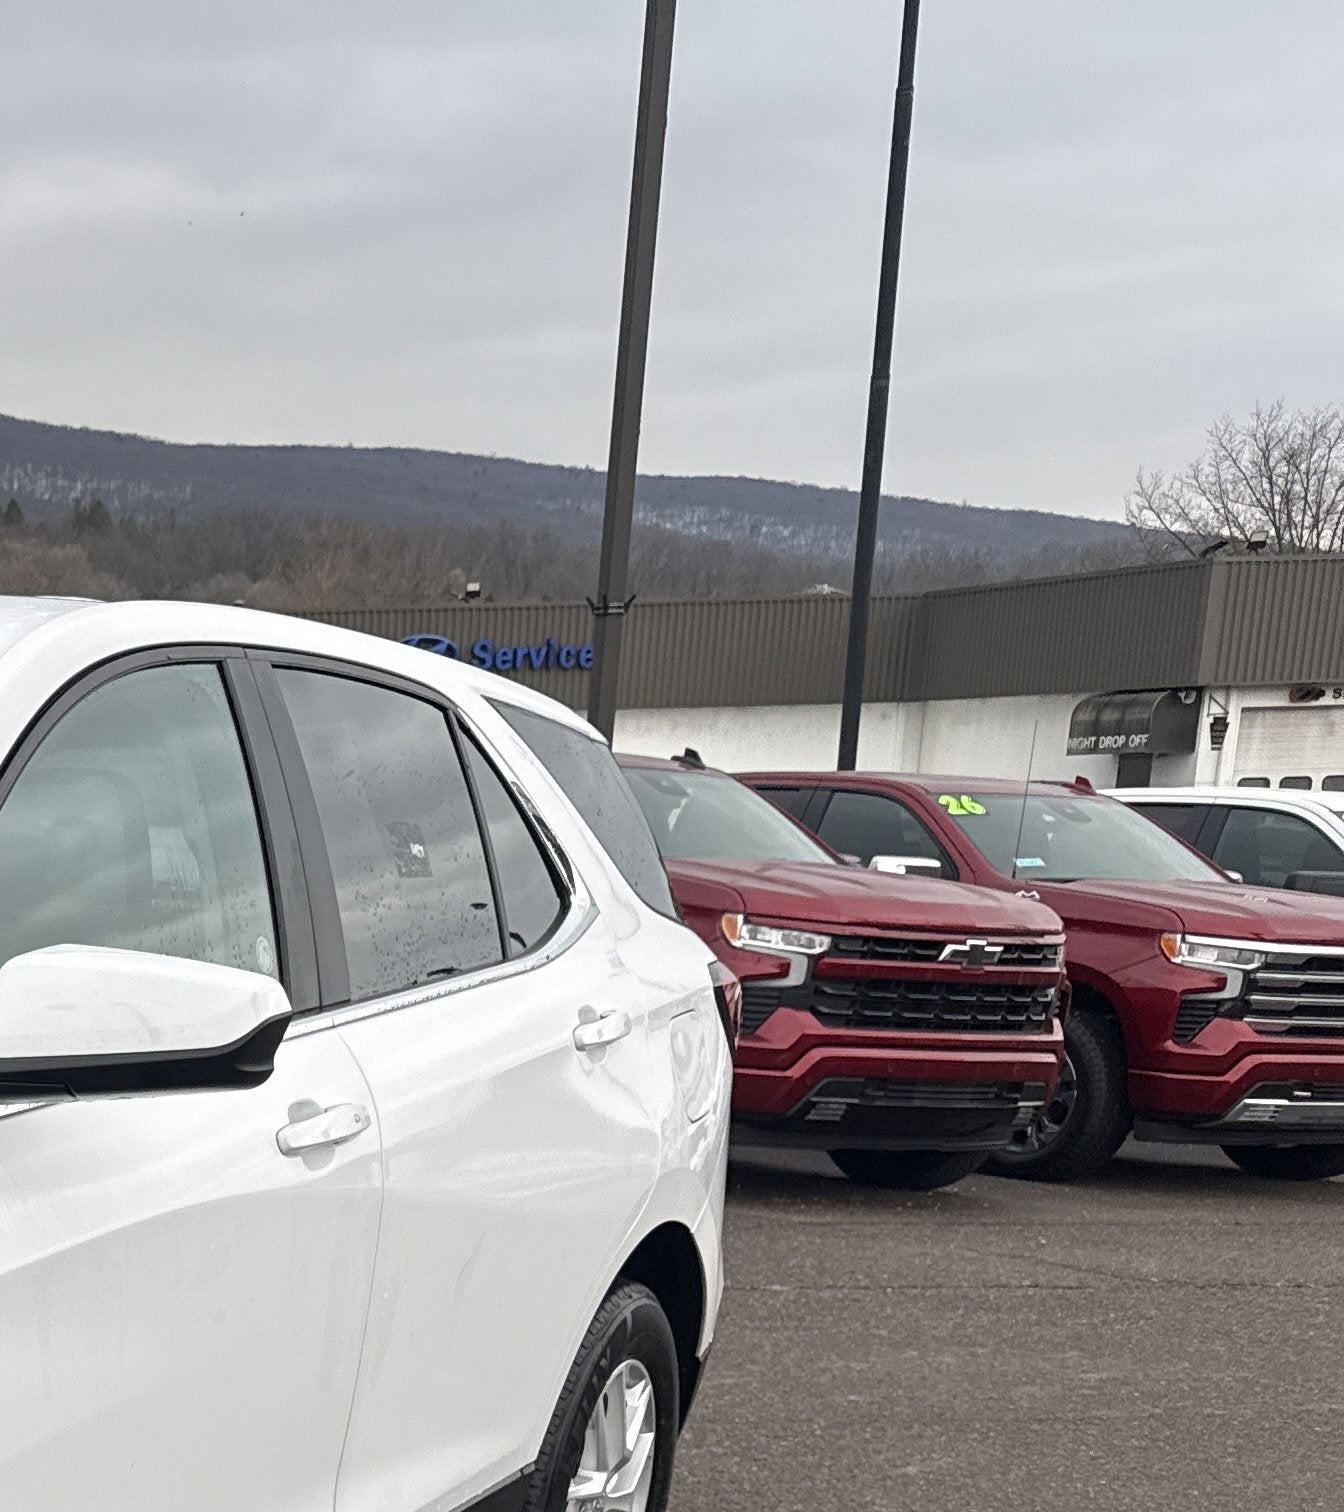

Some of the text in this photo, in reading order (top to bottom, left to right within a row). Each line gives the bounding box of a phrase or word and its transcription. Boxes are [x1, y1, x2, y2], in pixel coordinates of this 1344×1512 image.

[471, 637, 593, 669] Service
[1067, 733, 1150, 750] NIGHT DROP OFF
[938, 794, 987, 815] 26
